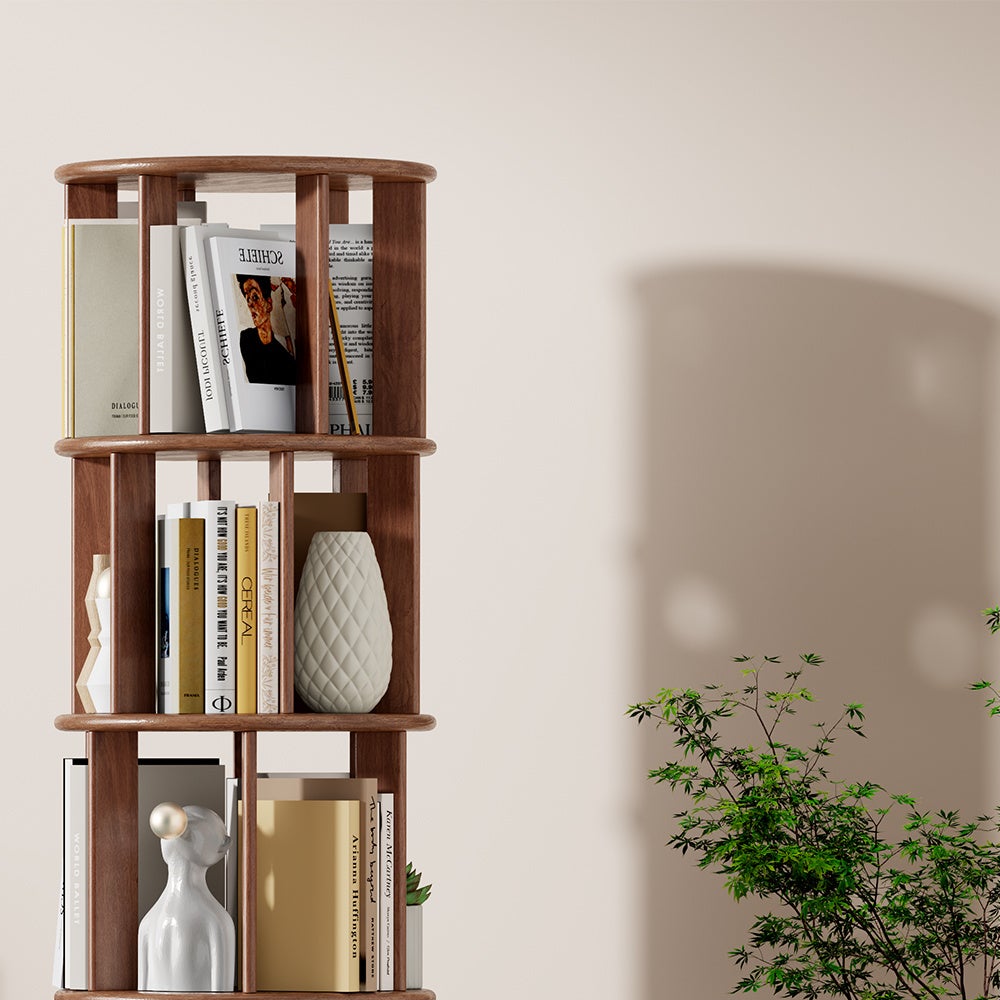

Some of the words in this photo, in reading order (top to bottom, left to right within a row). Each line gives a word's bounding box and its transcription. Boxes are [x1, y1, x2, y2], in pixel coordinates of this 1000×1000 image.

[217, 506, 228, 515] IT'S
[217, 517, 228, 525] NOT
[217, 527, 228, 537] HOW
[217, 539, 228, 550] GOOD
[217, 552, 228, 561] YOU
[217, 575, 228, 583] IT'S
[217, 585, 228, 595] HOW
[217, 596, 228, 608] GOOD
[217, 610, 228, 618] YOU
[242, 577, 253, 645] CEREAL
[217, 620, 228, 632] WANT
[217, 657, 228, 667] Paul
[217, 668, 228, 681] Arden
[384, 843, 393, 898] McCartney
[351, 889, 359, 958] Huffington
